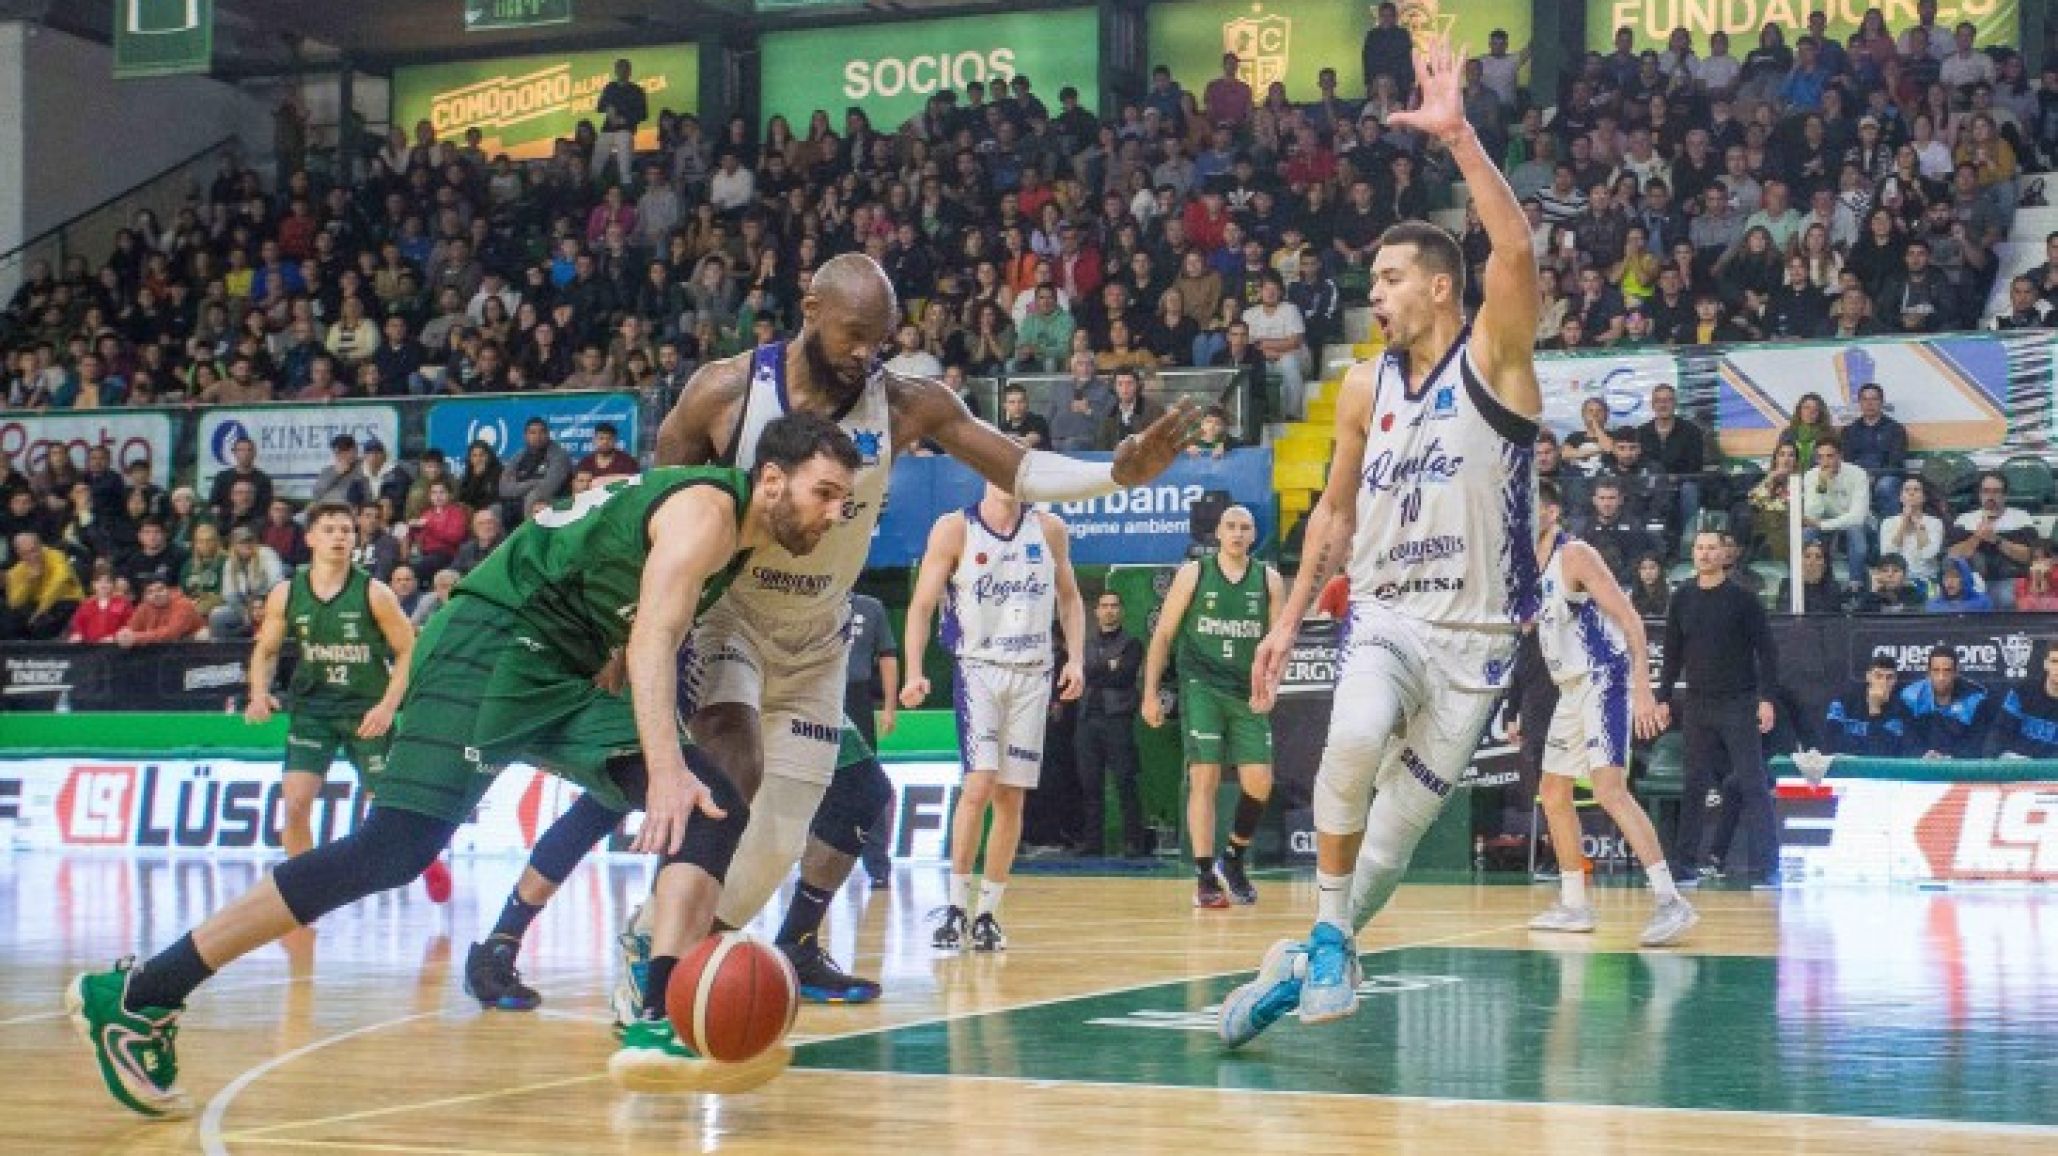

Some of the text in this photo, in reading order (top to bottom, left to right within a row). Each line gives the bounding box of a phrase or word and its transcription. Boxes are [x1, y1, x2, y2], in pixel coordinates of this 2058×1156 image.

[843, 47, 1015, 99] SOCIOS
[433, 73, 571, 130] COMODORO
[1363, 437, 1464, 496] Ratas
[1068, 518, 1190, 539] igiene ambient
[1285, 662, 1337, 680] ERGY
[791, 718, 839, 744] SHON
